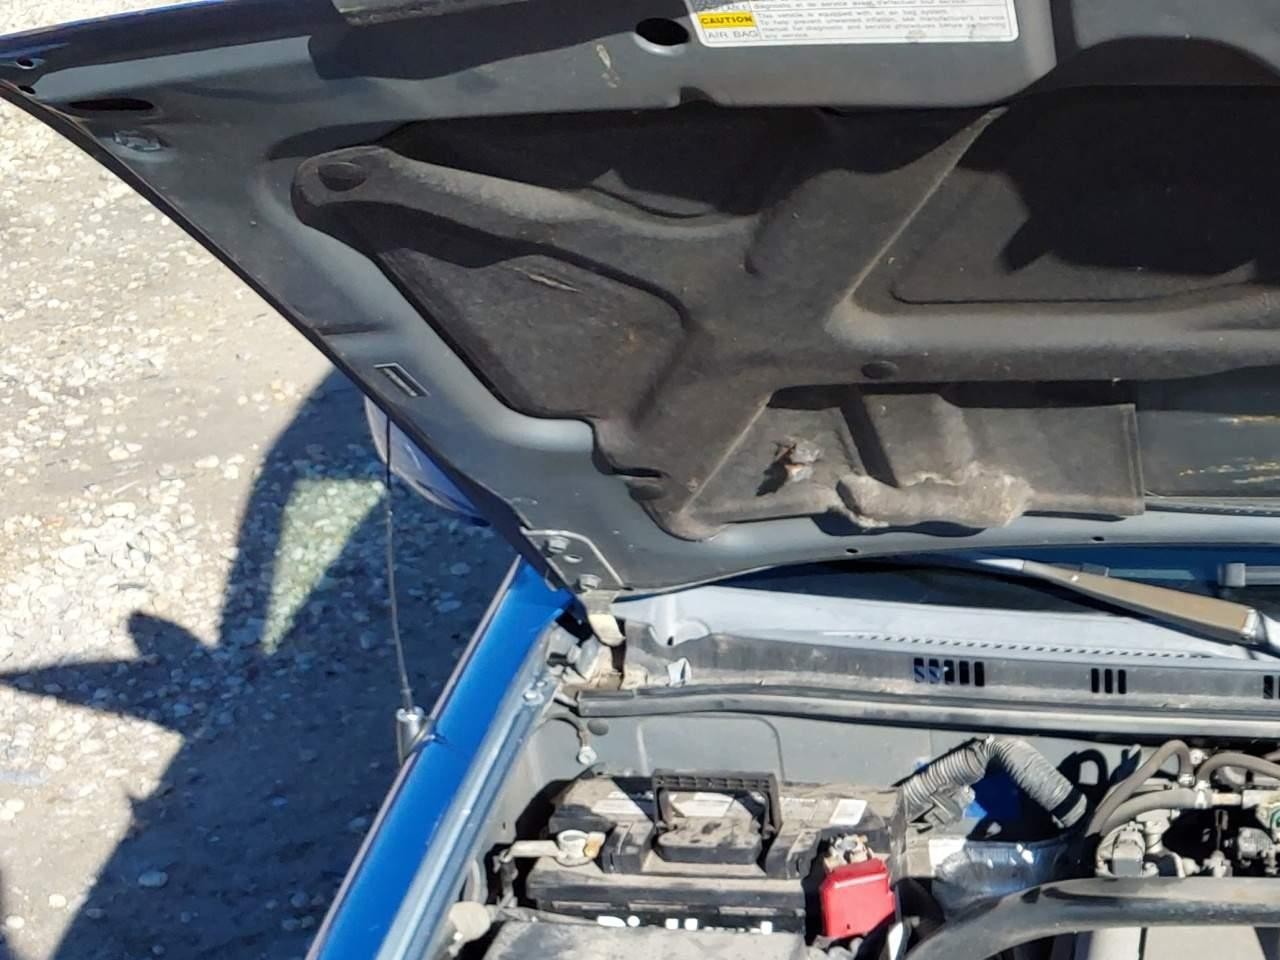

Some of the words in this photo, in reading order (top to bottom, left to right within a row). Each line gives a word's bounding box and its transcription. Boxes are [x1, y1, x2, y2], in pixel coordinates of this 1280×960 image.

[700, 14, 753, 24] CAUTION
[708, 31, 729, 40] AIR
[733, 29, 758, 39] BAG
